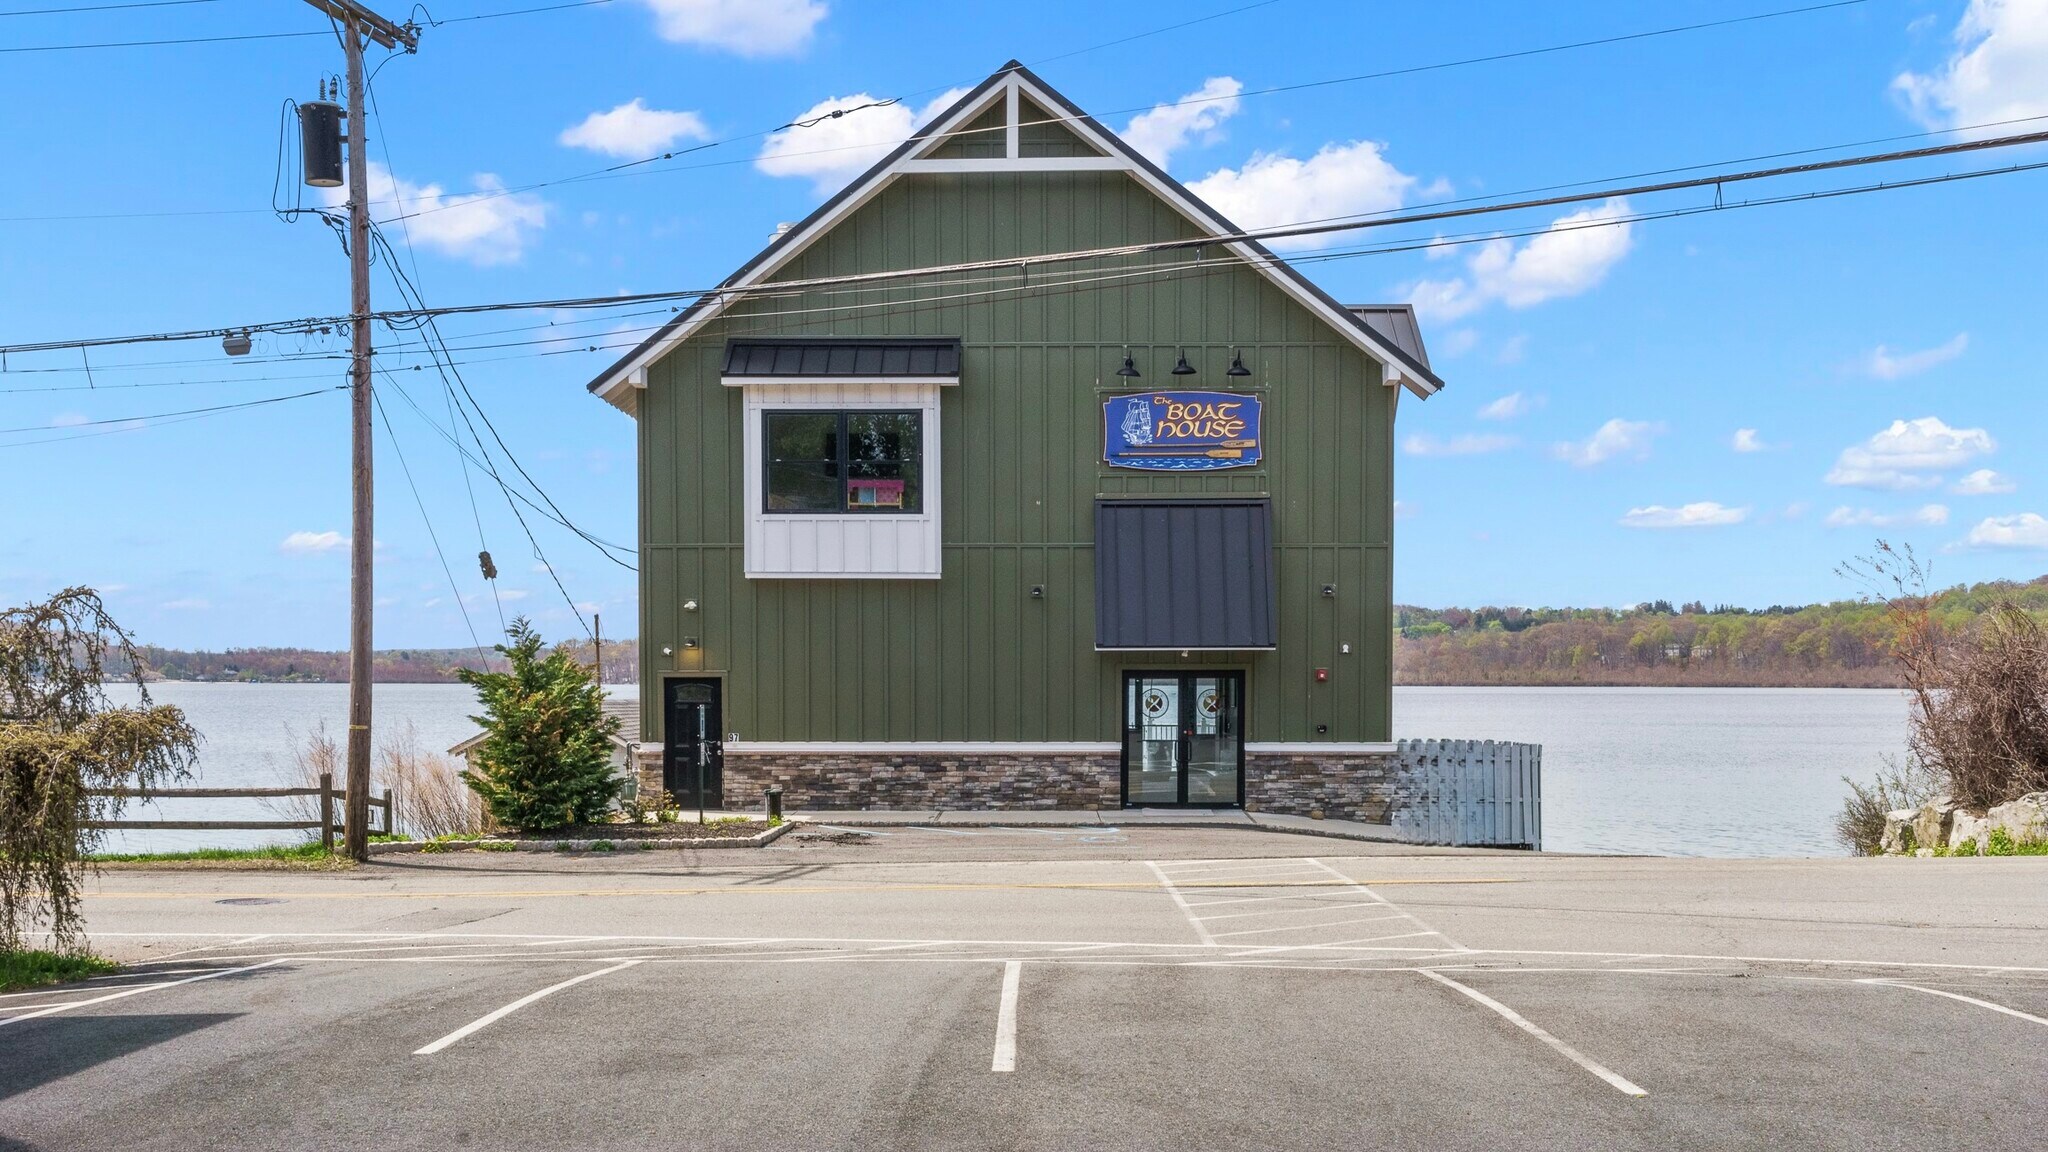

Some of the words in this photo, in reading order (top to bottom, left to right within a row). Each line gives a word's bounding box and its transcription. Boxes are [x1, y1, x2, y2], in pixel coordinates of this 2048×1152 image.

[1154, 396, 1173, 405] The
[1167, 403, 1241, 420] BOAT
[729, 733, 739, 742] 97
